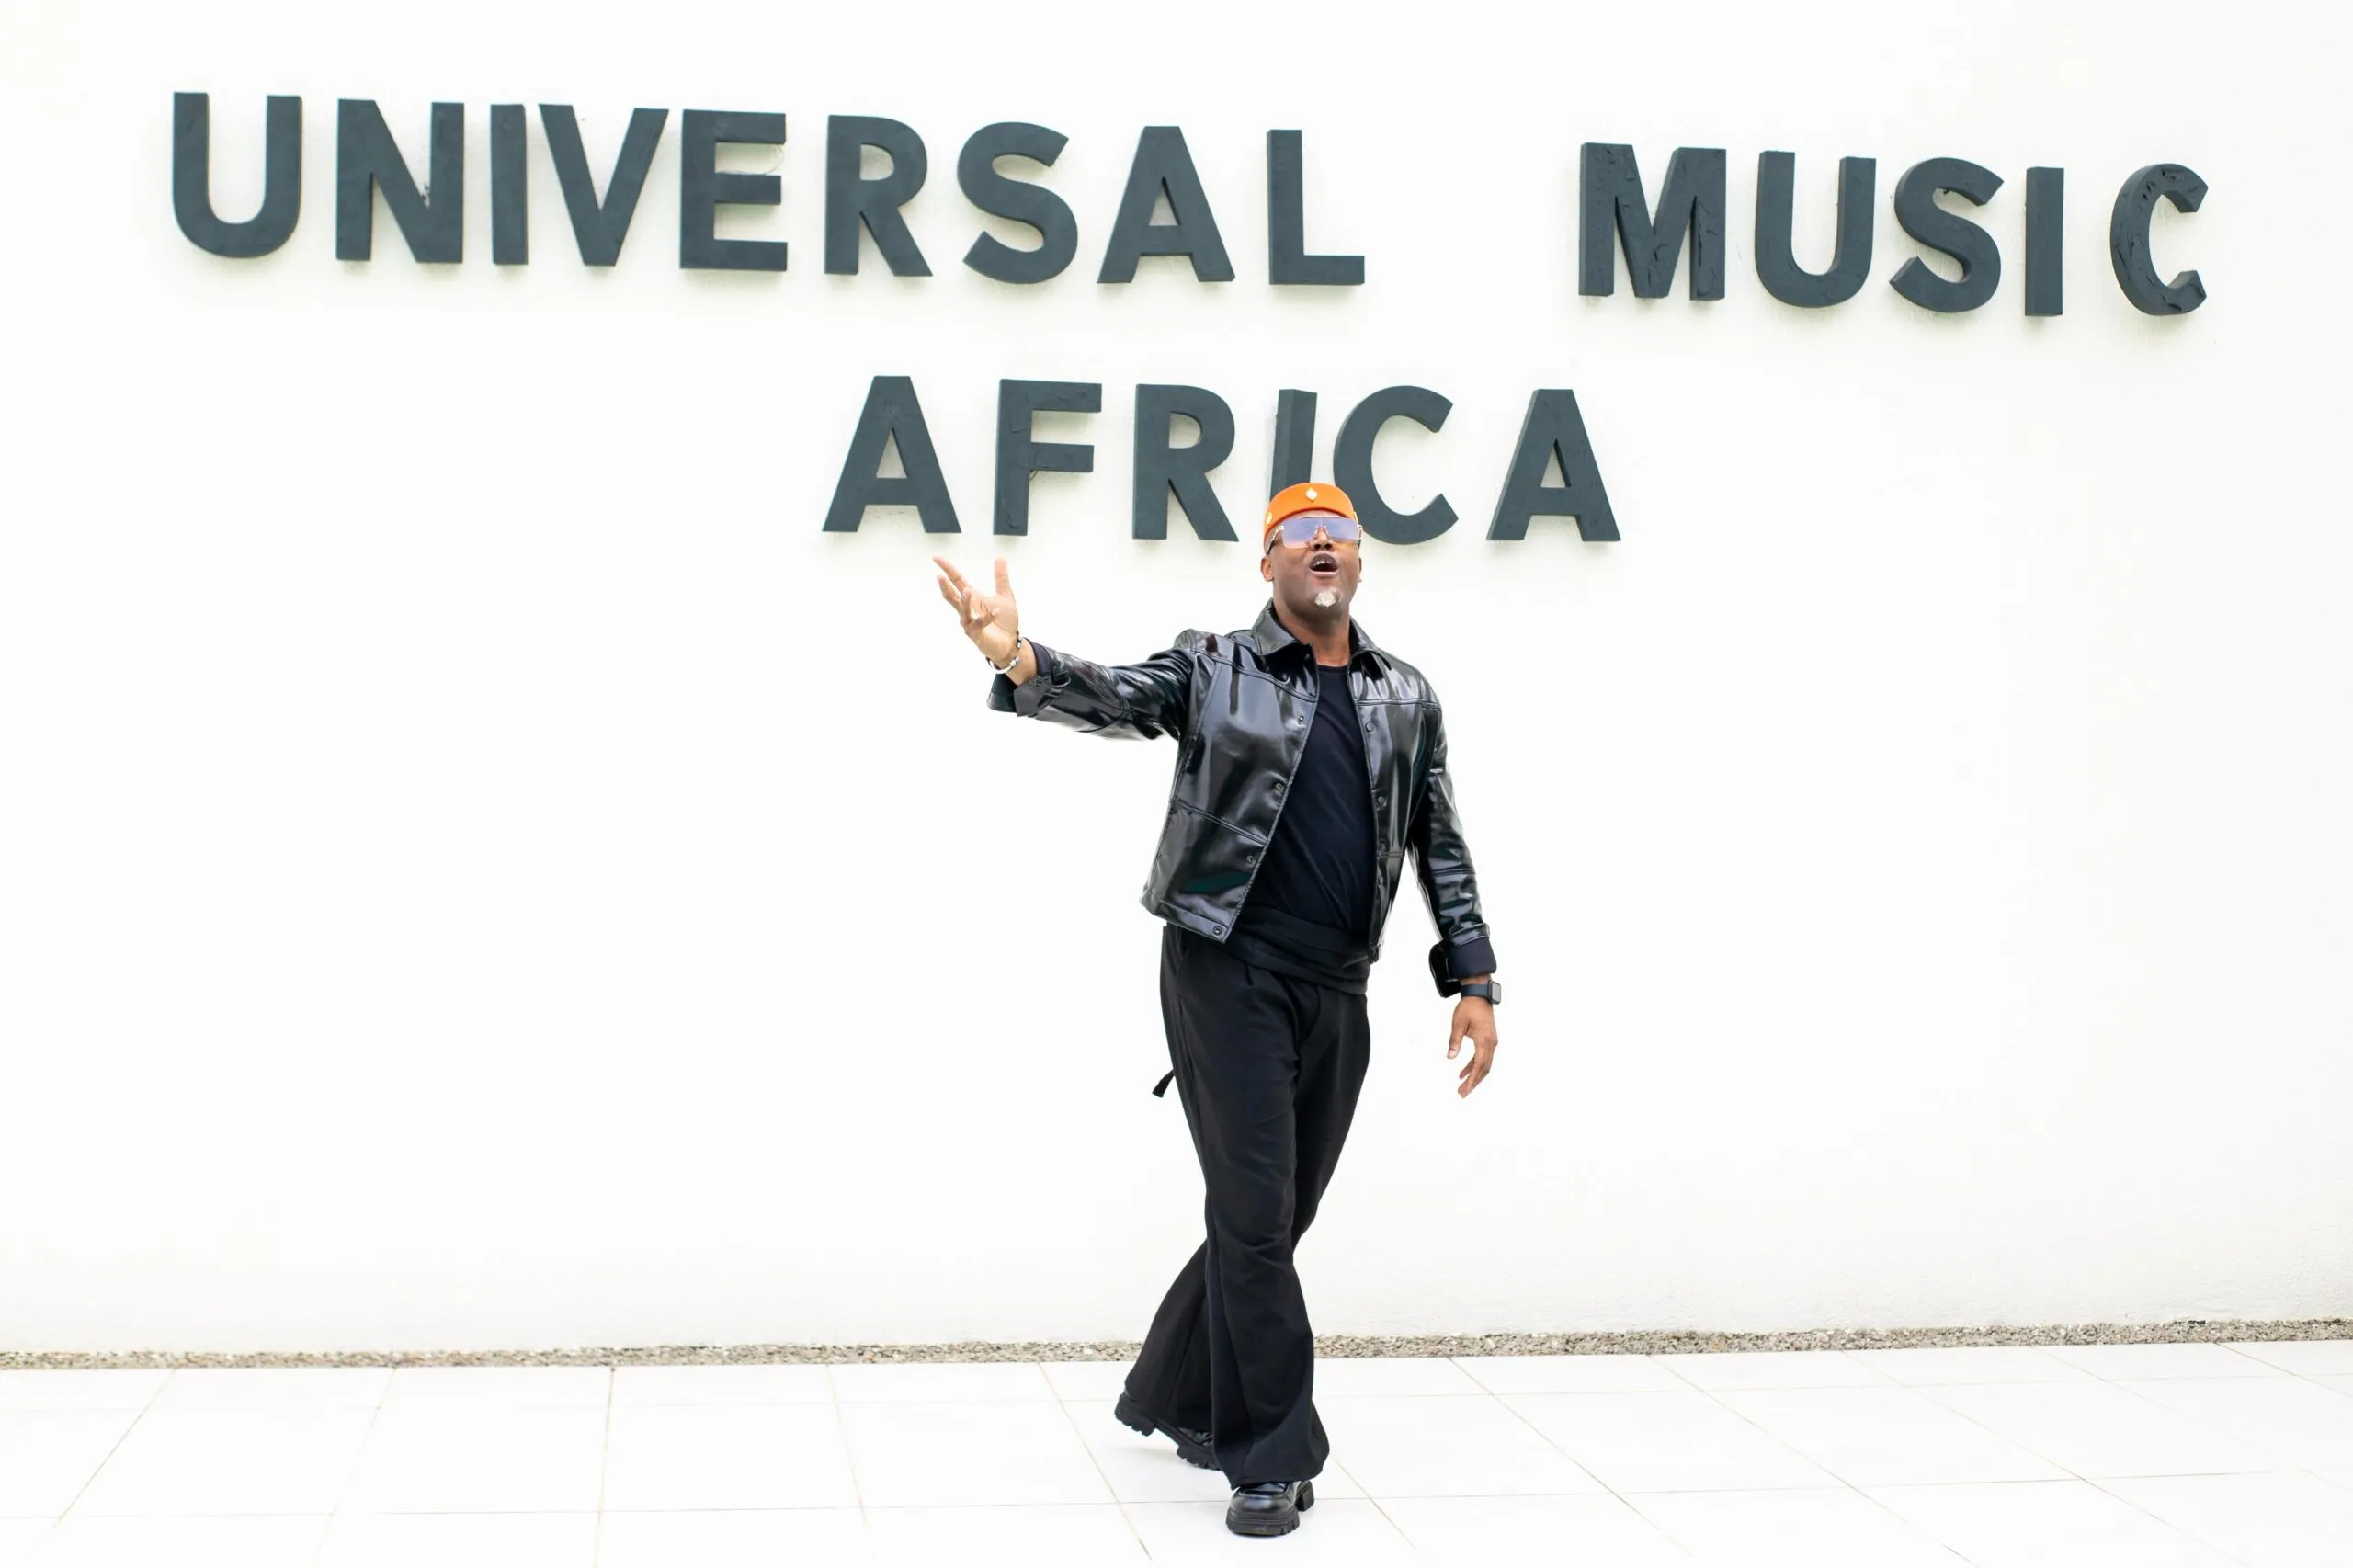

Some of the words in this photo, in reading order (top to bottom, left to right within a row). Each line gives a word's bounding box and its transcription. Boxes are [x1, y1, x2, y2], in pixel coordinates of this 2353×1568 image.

[172, 92, 1366, 286] UNIVERSAL
[1578, 142, 2209, 317] MUSIC
[823, 375, 1621, 544] AFRICA
